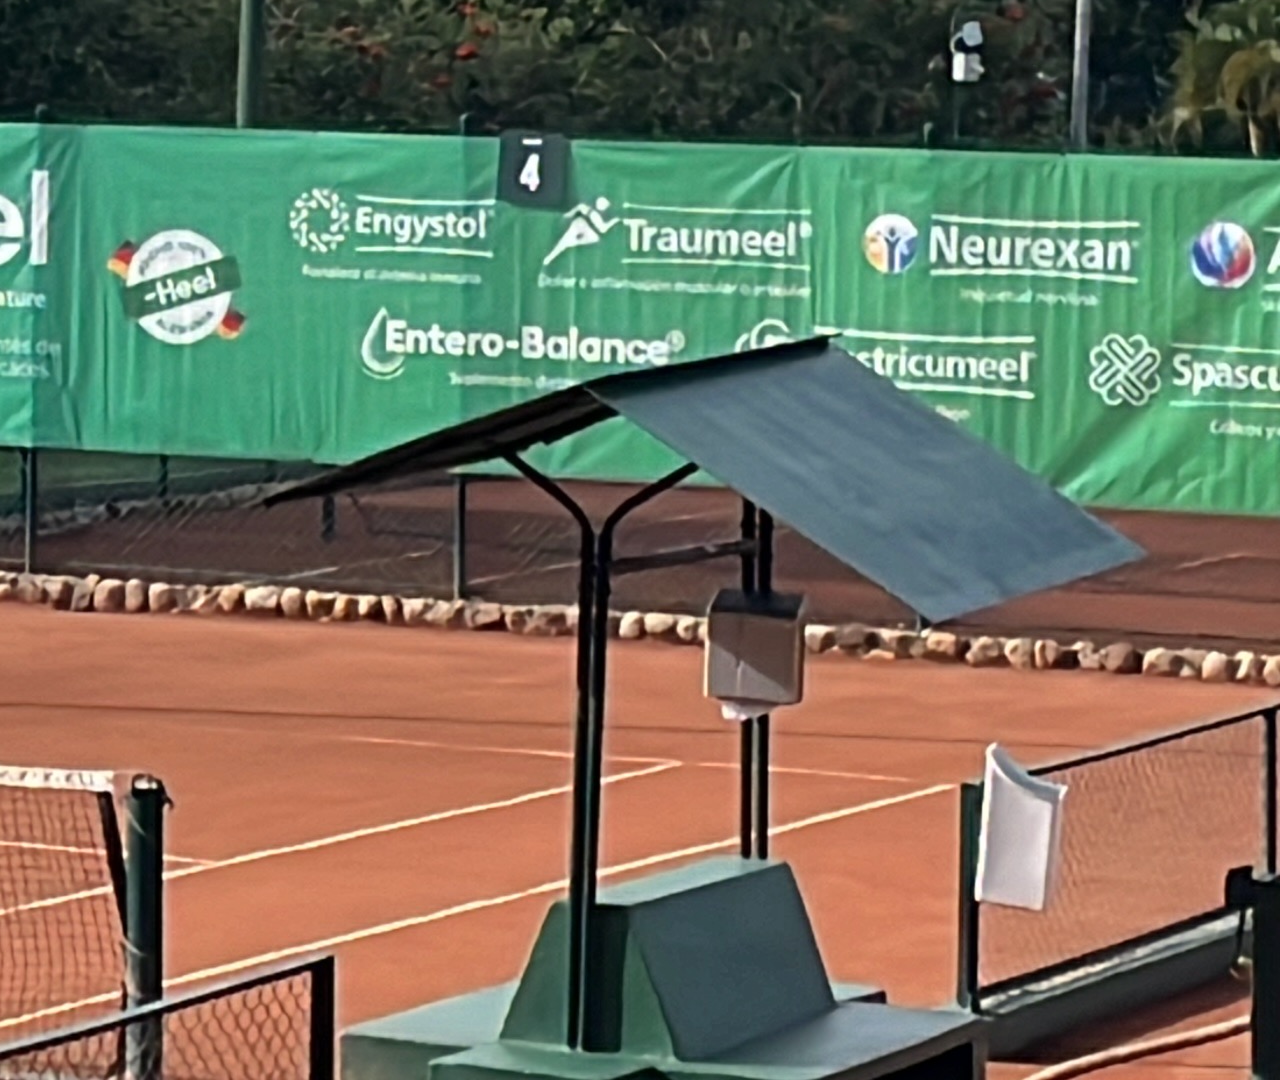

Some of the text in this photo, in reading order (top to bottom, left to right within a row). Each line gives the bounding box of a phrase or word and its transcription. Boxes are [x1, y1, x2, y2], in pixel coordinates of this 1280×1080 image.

[519, 152, 541, 193] 4
[355, 206, 487, 245] Engystol
[928, 225, 1131, 272] Neurexan
[856, 345, 1029, 383] stricumeel
